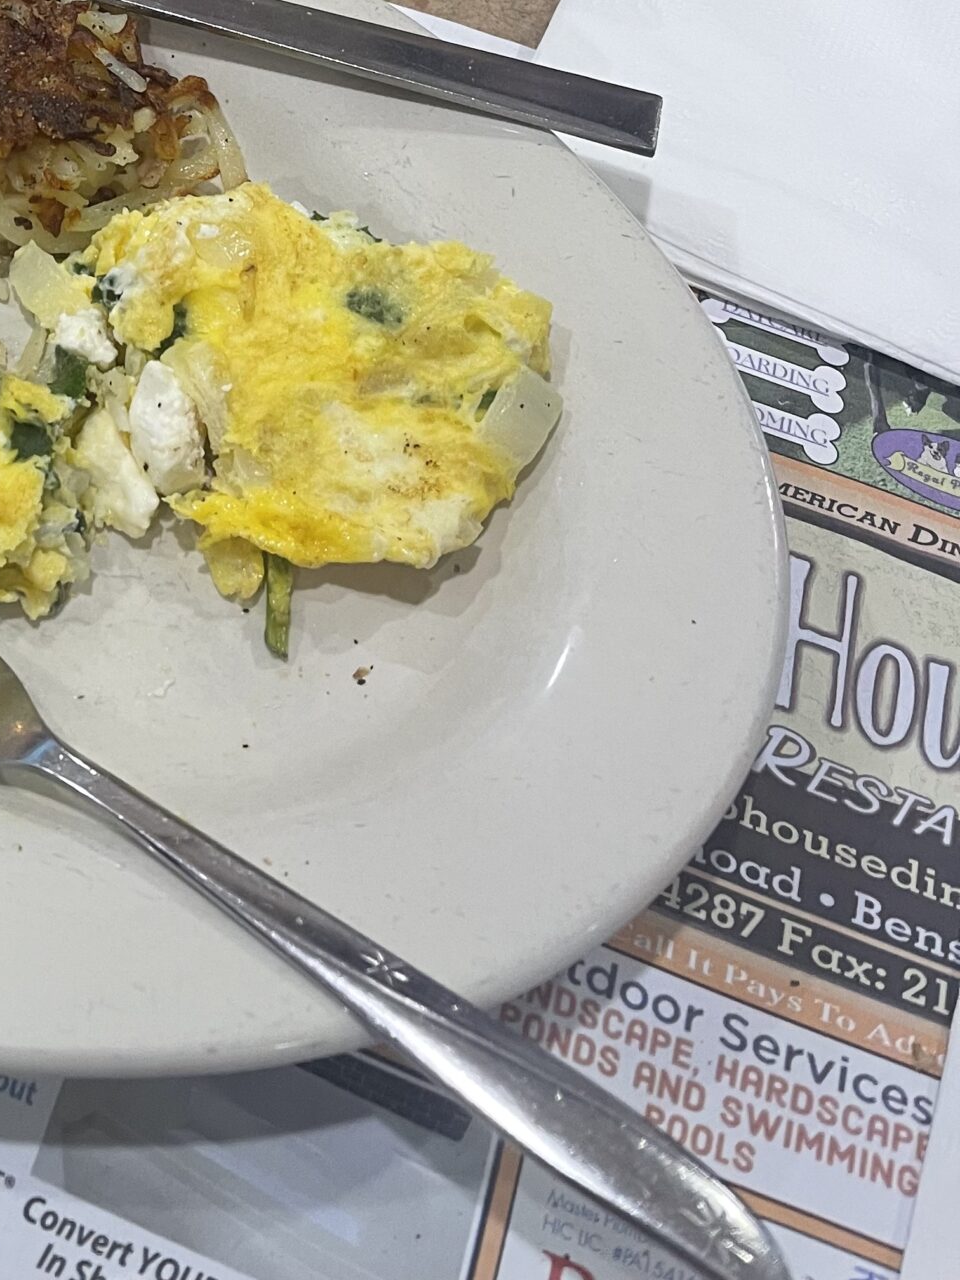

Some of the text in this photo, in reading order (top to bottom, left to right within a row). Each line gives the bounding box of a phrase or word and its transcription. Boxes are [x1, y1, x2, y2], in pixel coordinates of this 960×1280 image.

[907, 462, 946, 486] Regal
[688, 949, 712, 977] It
[724, 963, 803, 1012] Pays
[814, 997, 856, 1032] To
[777, 918, 887, 990] Fax:
[901, 967, 950, 1016] 21
[499, 1002, 920, 1197] PONDS AND SWIMMING
[719, 1012, 934, 1126] Services
[644, 1103, 756, 1173] POOLS
[23, 1195, 134, 1268] Convert
[36, 1243, 67, 1278] In
